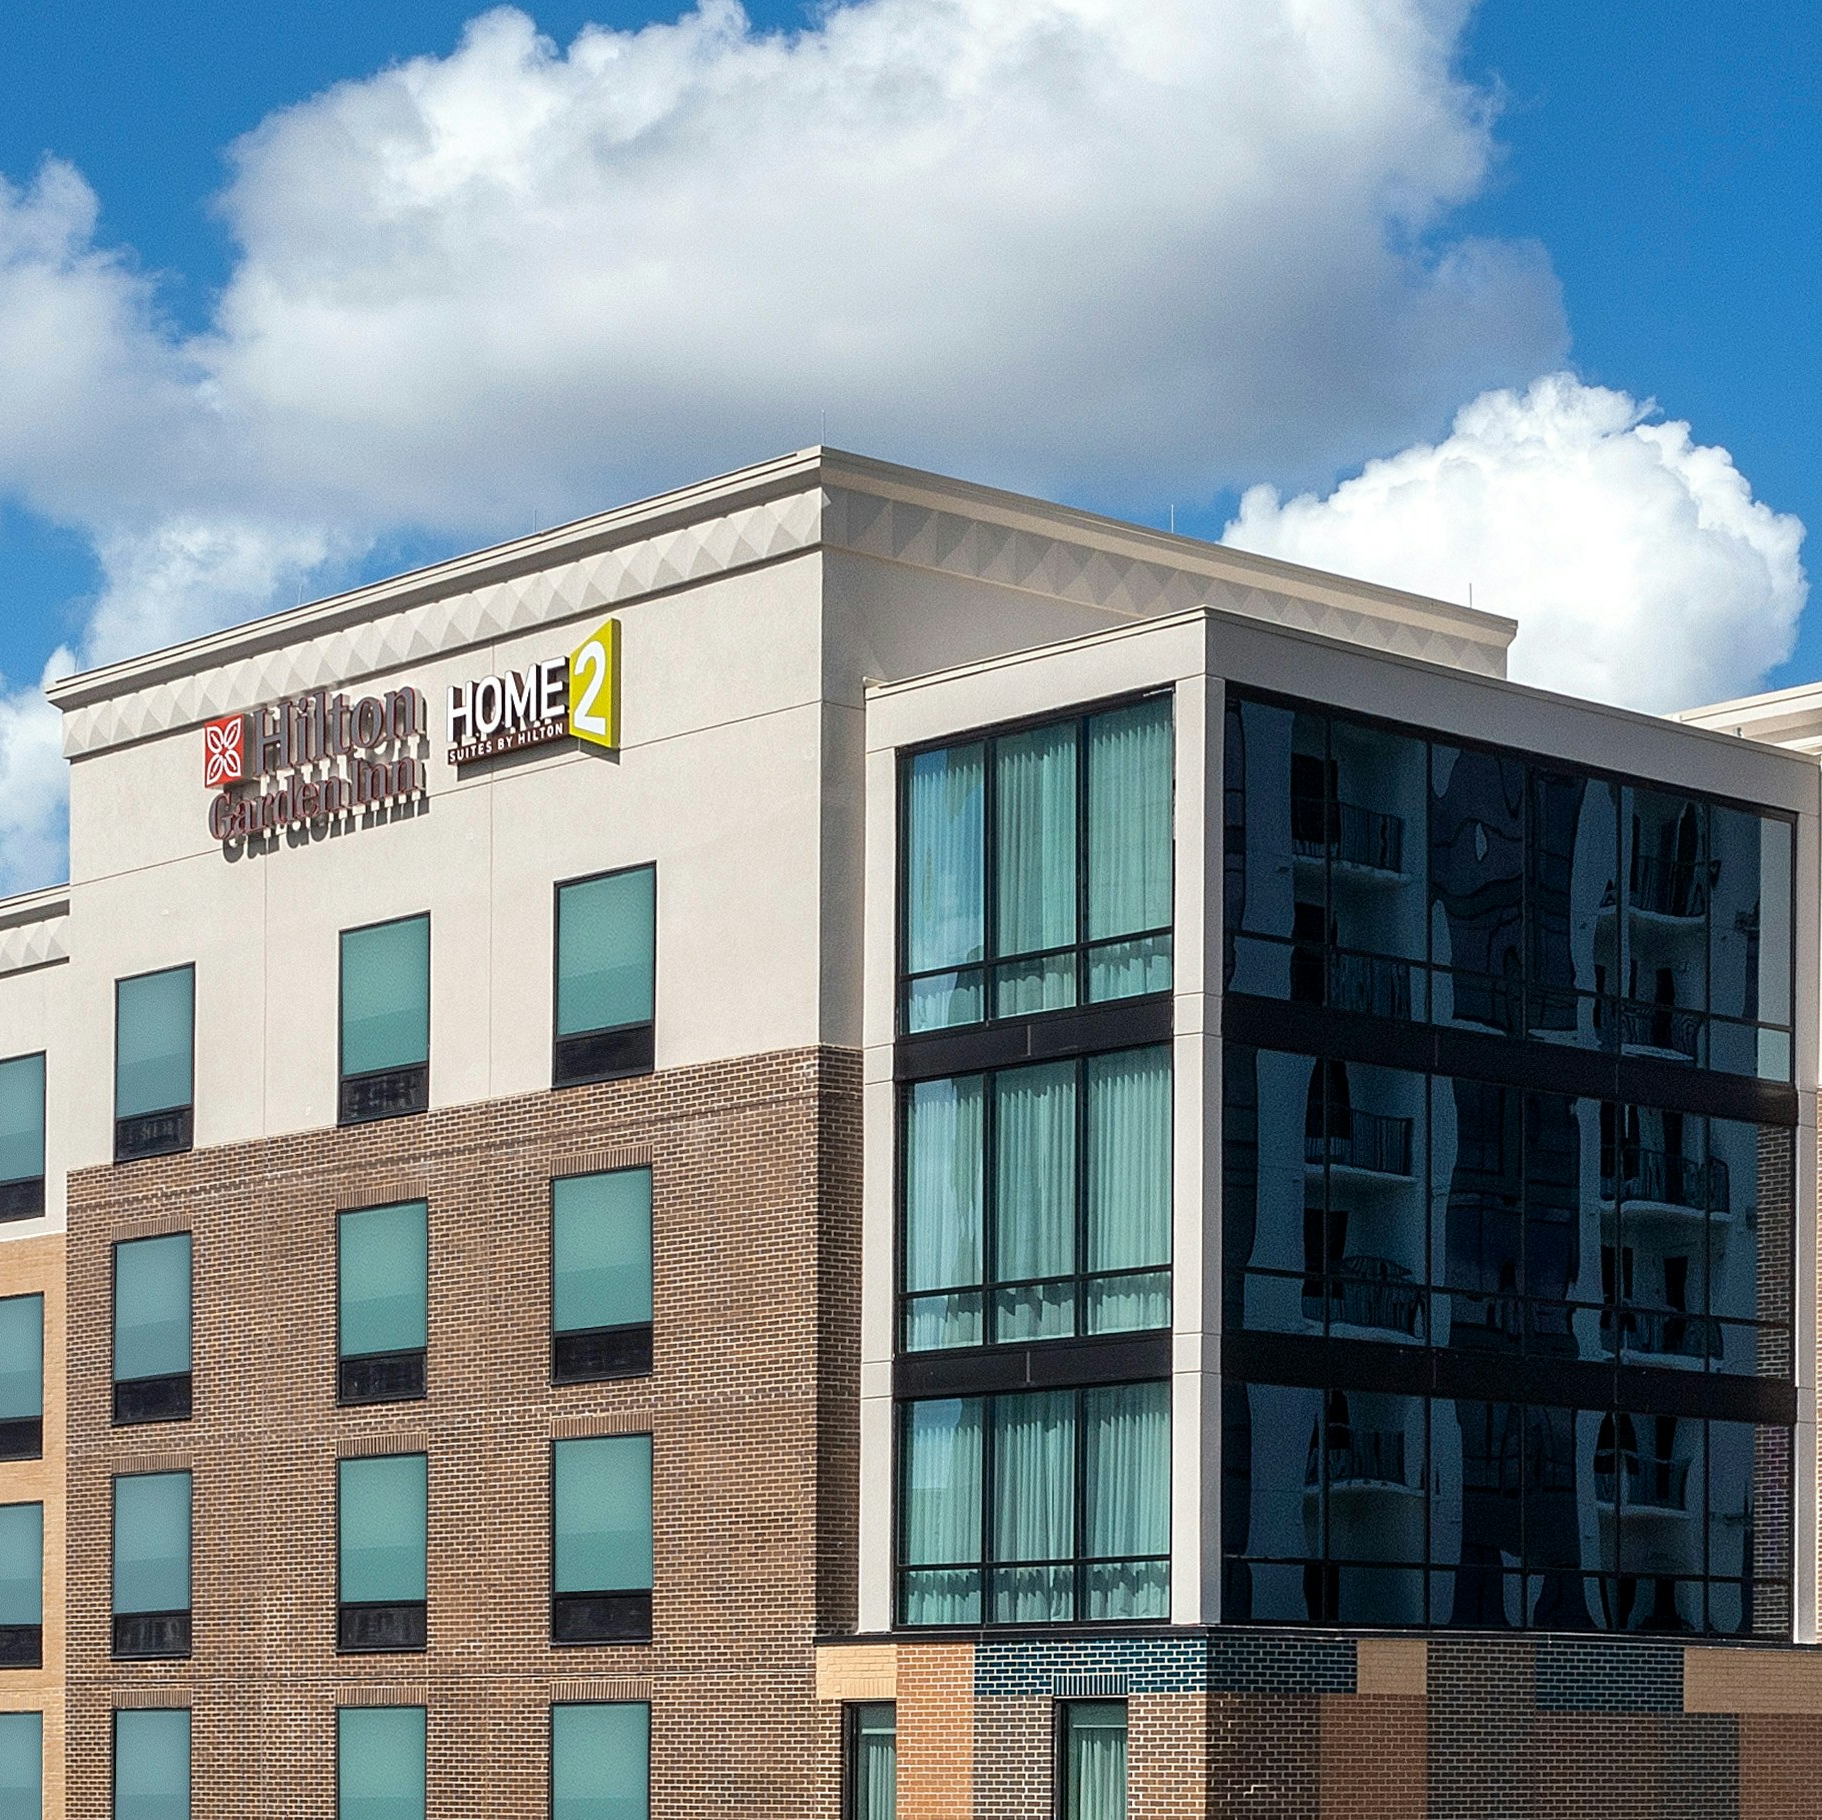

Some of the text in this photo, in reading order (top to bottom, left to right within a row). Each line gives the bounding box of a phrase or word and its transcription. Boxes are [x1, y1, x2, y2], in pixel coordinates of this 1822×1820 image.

[253, 686, 417, 778] Hilton
[447, 640, 606, 743] HOME 2
[449, 722, 564, 763] SUITES BY HILTON
[209, 756, 417, 840] Garden Inn
